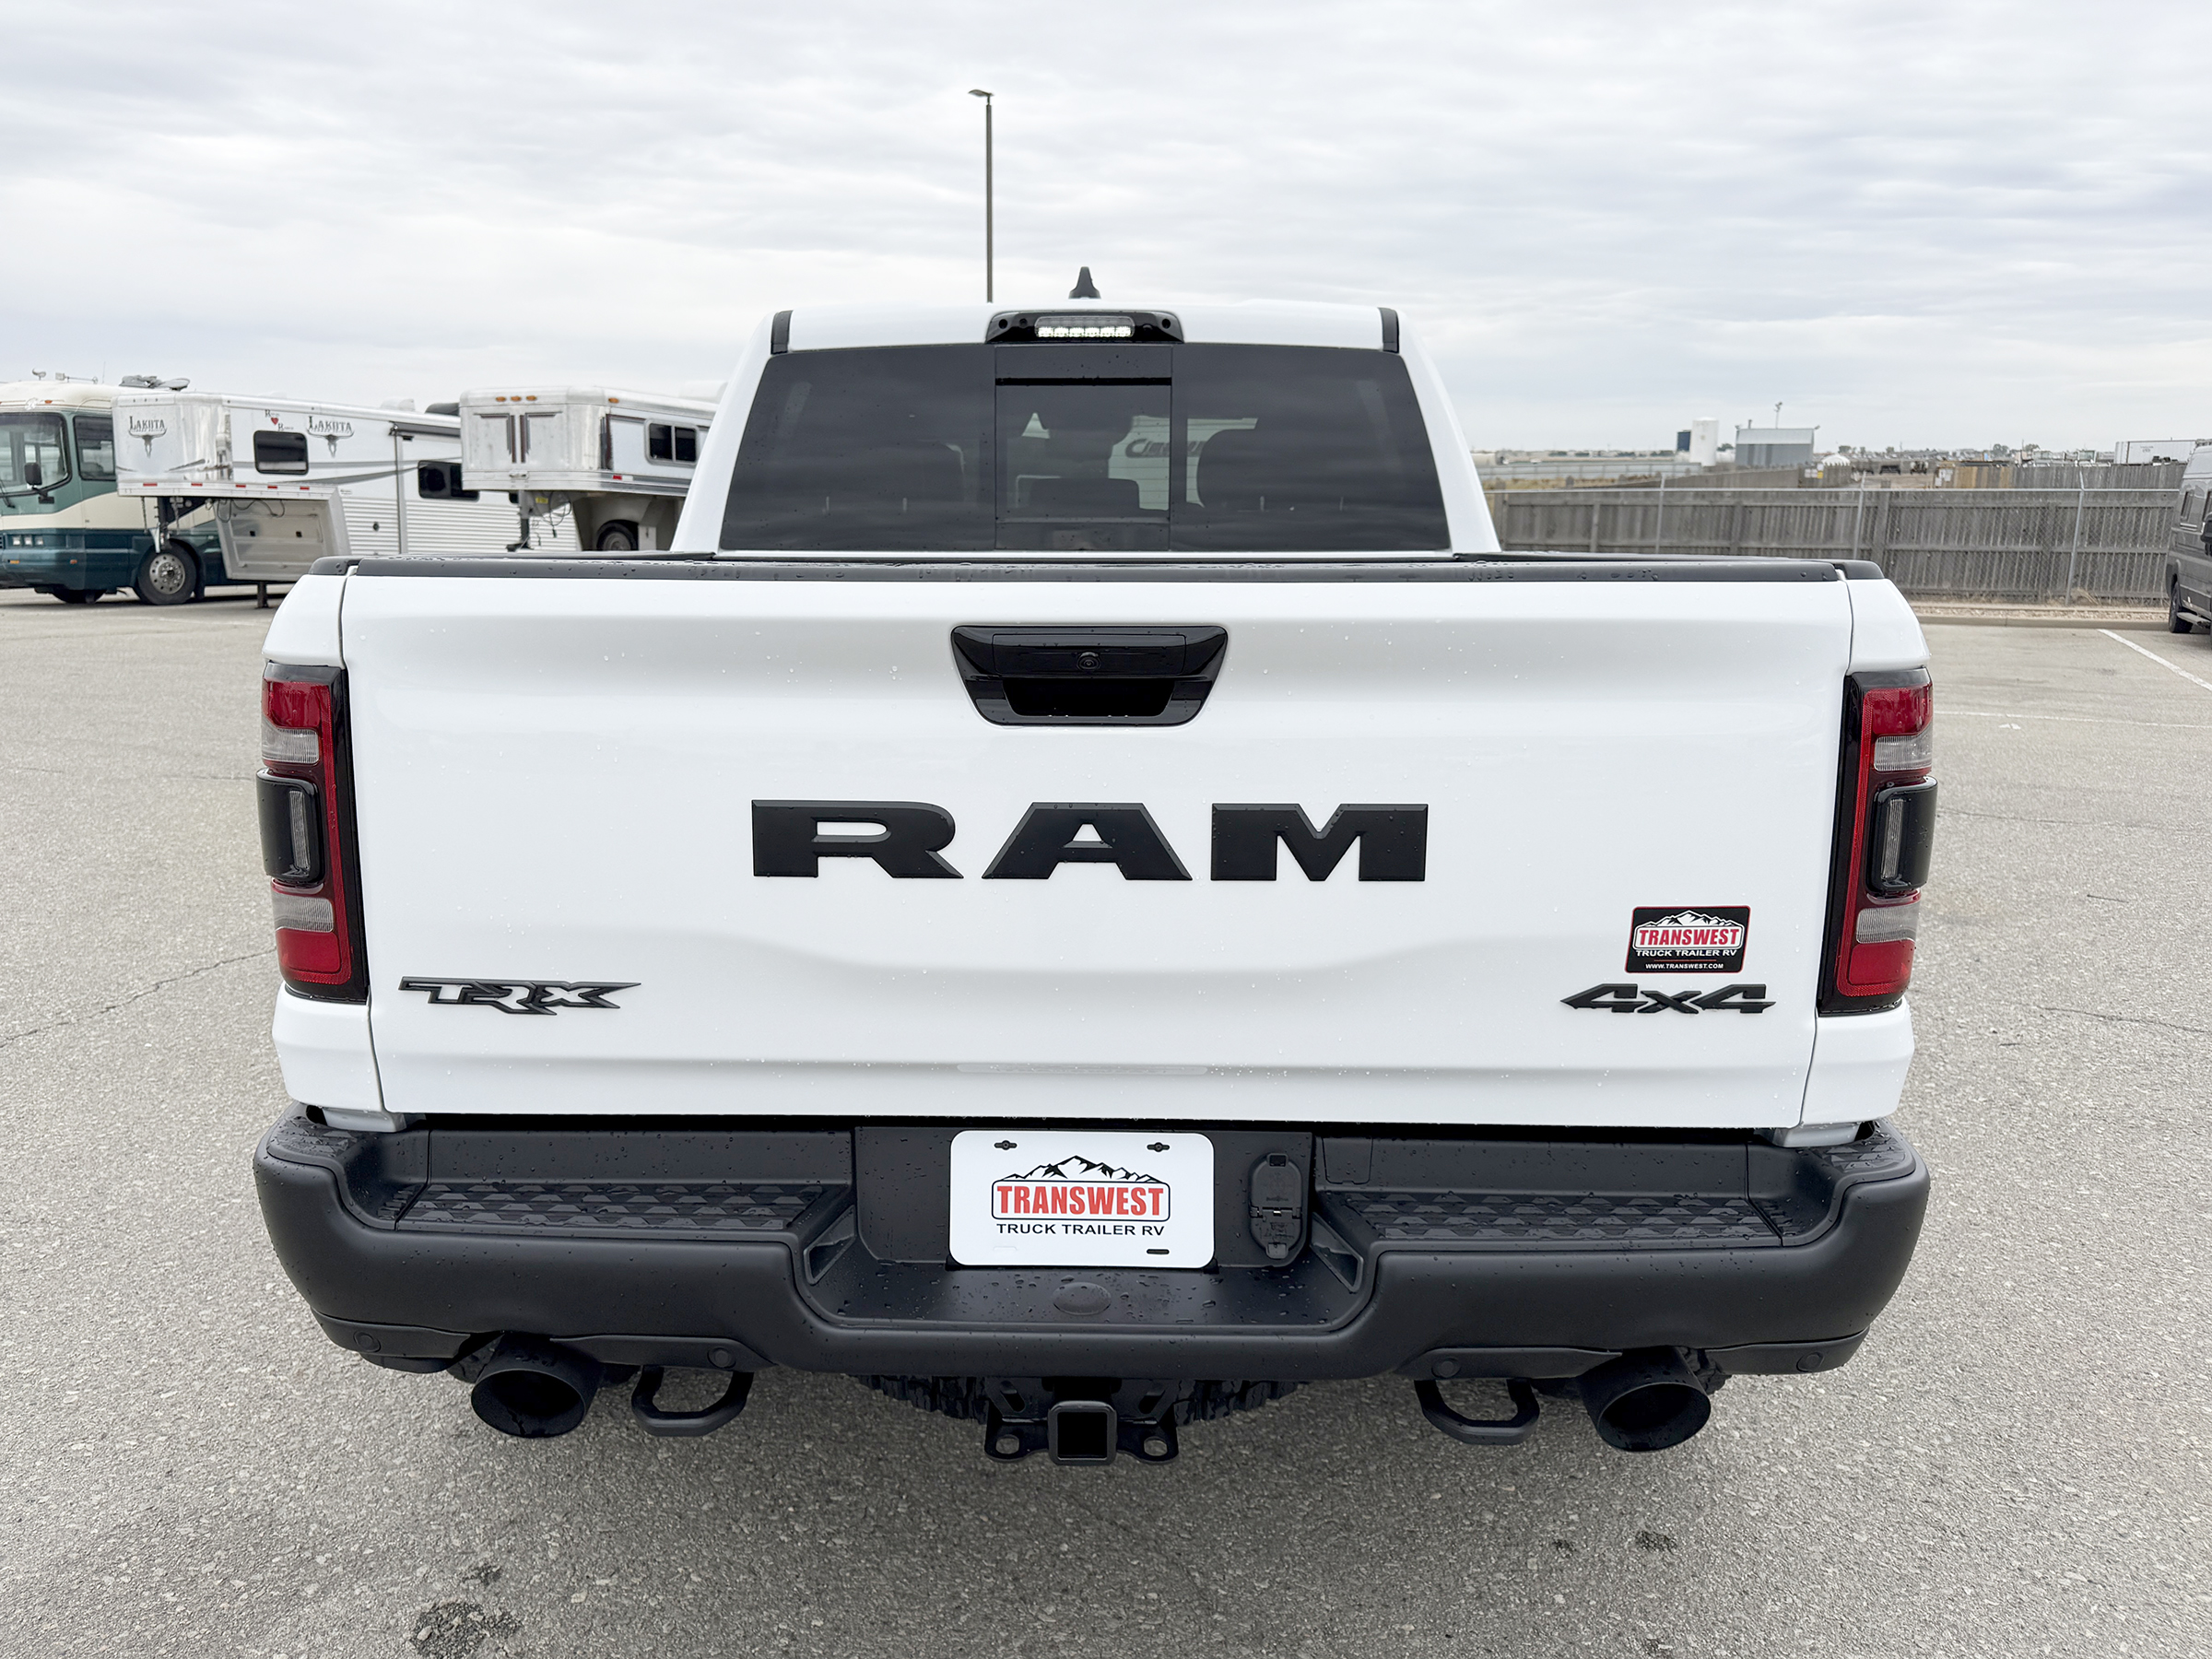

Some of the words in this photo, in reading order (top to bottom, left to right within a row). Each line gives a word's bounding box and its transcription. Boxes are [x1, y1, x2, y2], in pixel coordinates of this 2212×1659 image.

[751, 800, 1429, 882] RAM
[1639, 928, 1740, 946] TRANSWEST
[398, 976, 641, 1016] TRX
[996, 1185, 1164, 1217] TRANSWEST
[996, 1223, 1056, 1235] TRUCK
[1061, 1224, 1136, 1236] TRAILER
[1141, 1225, 1165, 1236] RV
